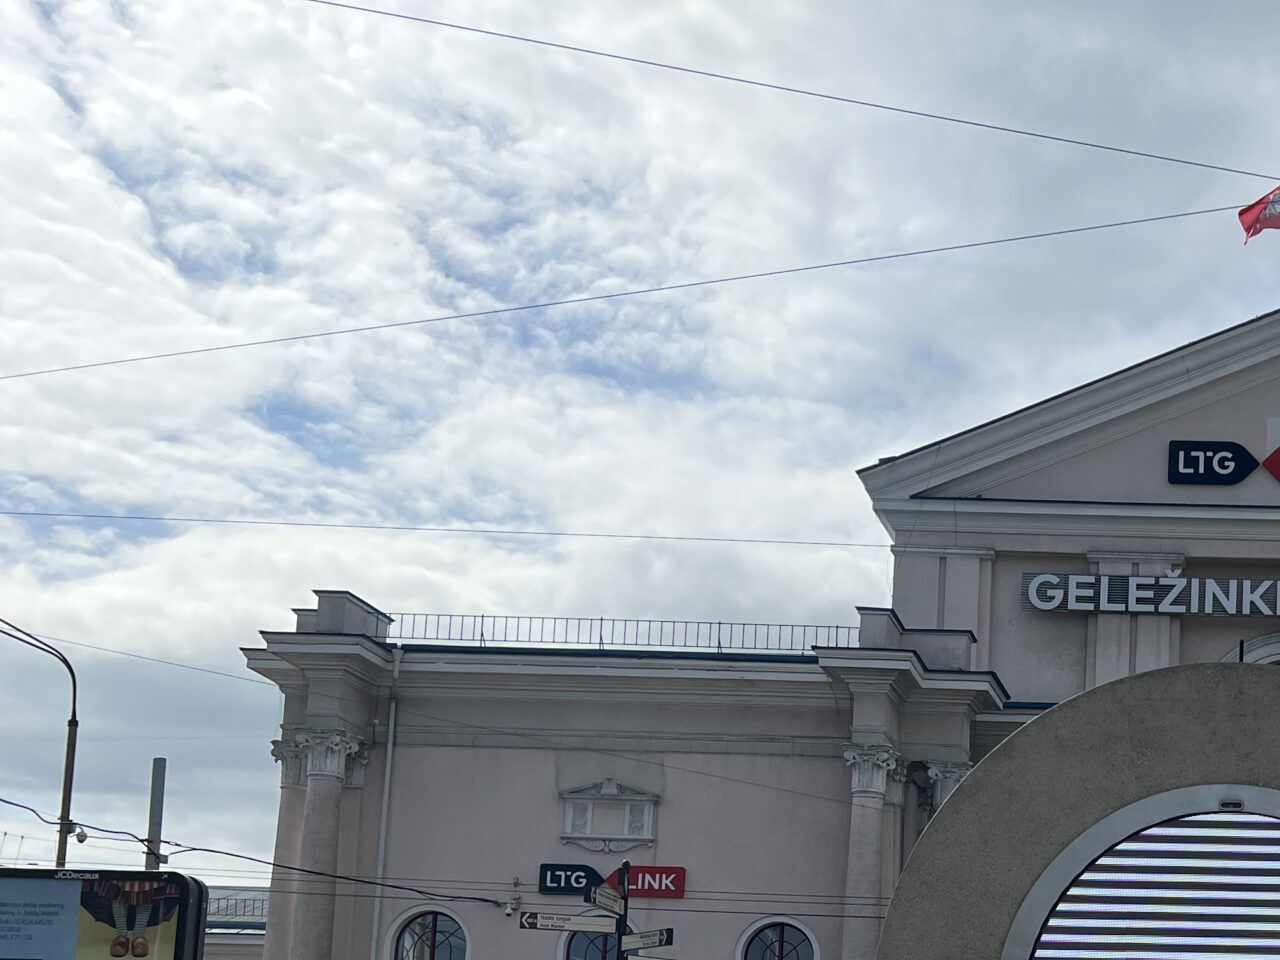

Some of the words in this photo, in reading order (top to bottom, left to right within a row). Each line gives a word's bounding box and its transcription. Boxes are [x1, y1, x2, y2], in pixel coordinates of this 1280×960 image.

[1178, 450, 1236, 475] LTG
[54, 871, 100, 880] JCDecaux
[546, 870, 588, 889] LTG
